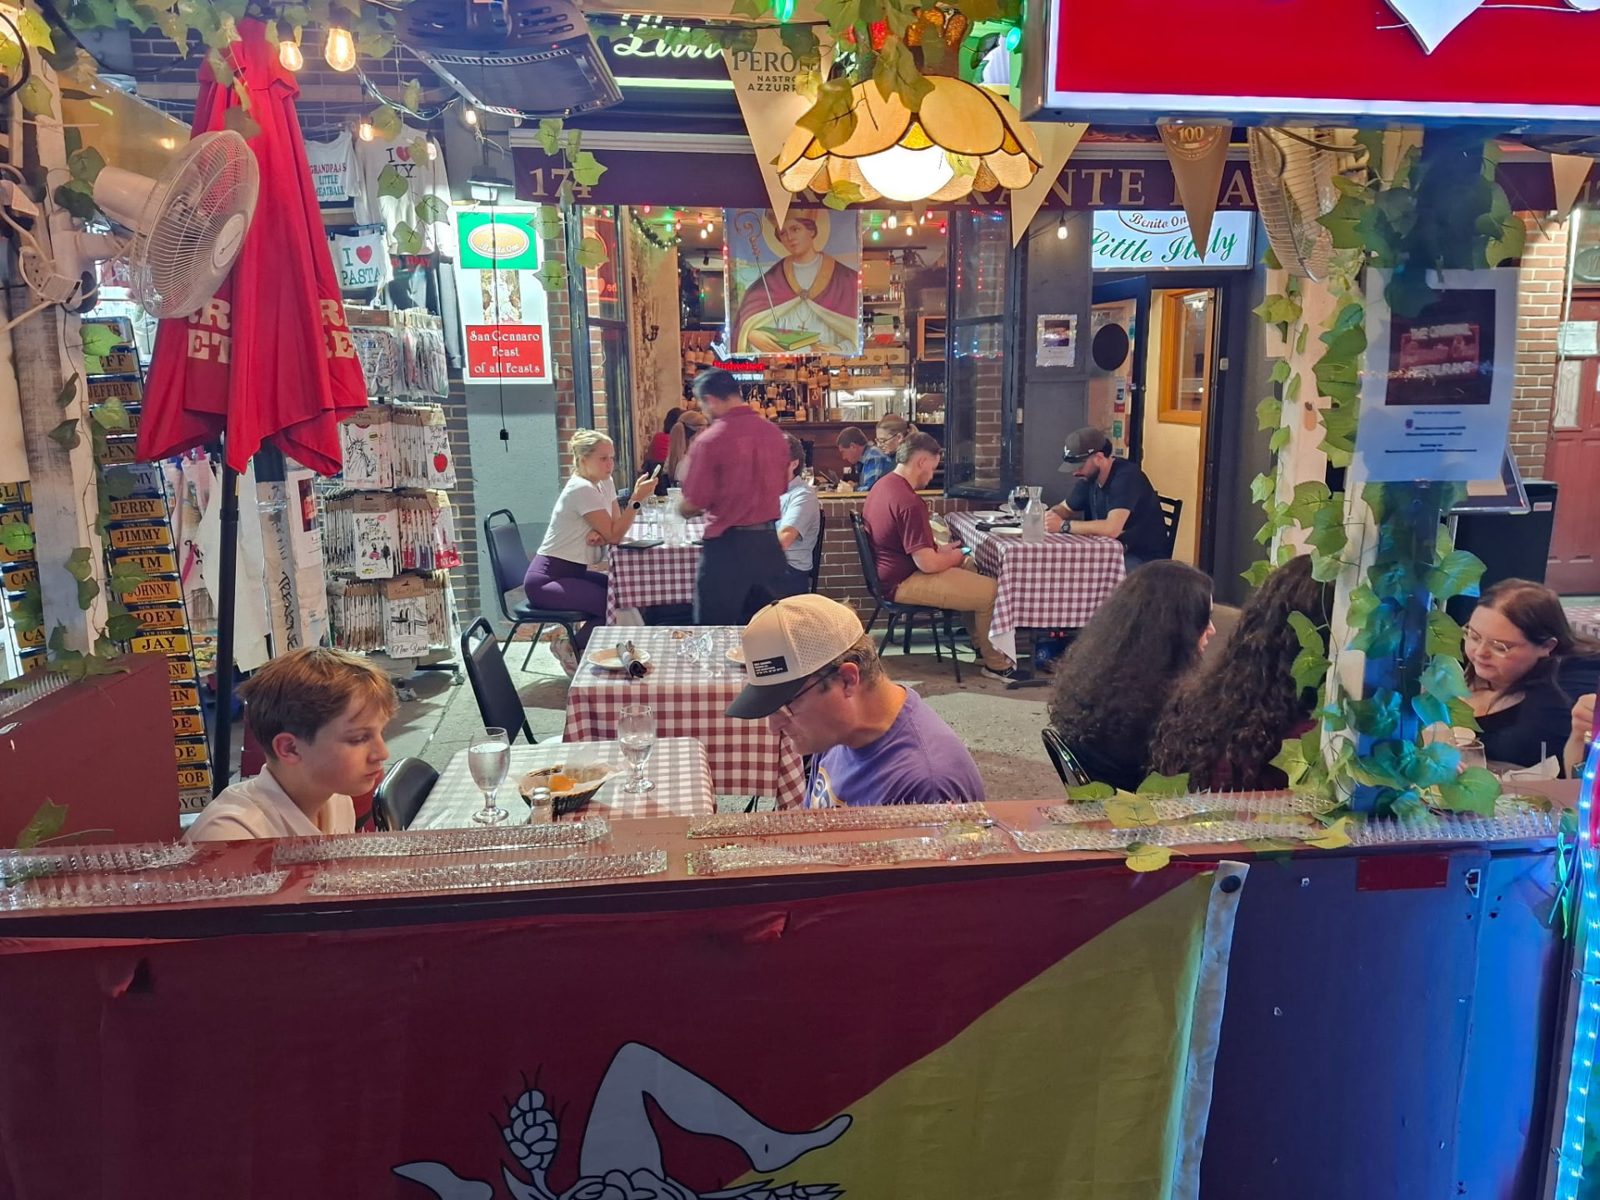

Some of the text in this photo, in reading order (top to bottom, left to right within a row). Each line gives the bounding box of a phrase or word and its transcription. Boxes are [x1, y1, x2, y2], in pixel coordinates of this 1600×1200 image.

[733, 51, 821, 73] PERO
[319, 175, 338, 185] LITTLE
[1129, 212, 1189, 229] Benito On
[1161, 227, 1238, 263] Itly
[342, 248, 353, 266] I
[342, 267, 380, 286] PASTA
[469, 330, 540, 342] San Gennaro
[491, 345, 520, 357] Feast
[474, 362, 487, 374] of
[506, 362, 541, 374] Feasts
[111, 500, 156, 514] JERRY
[117, 528, 161, 543] JIMMY
[142, 637, 176, 651] JAY
